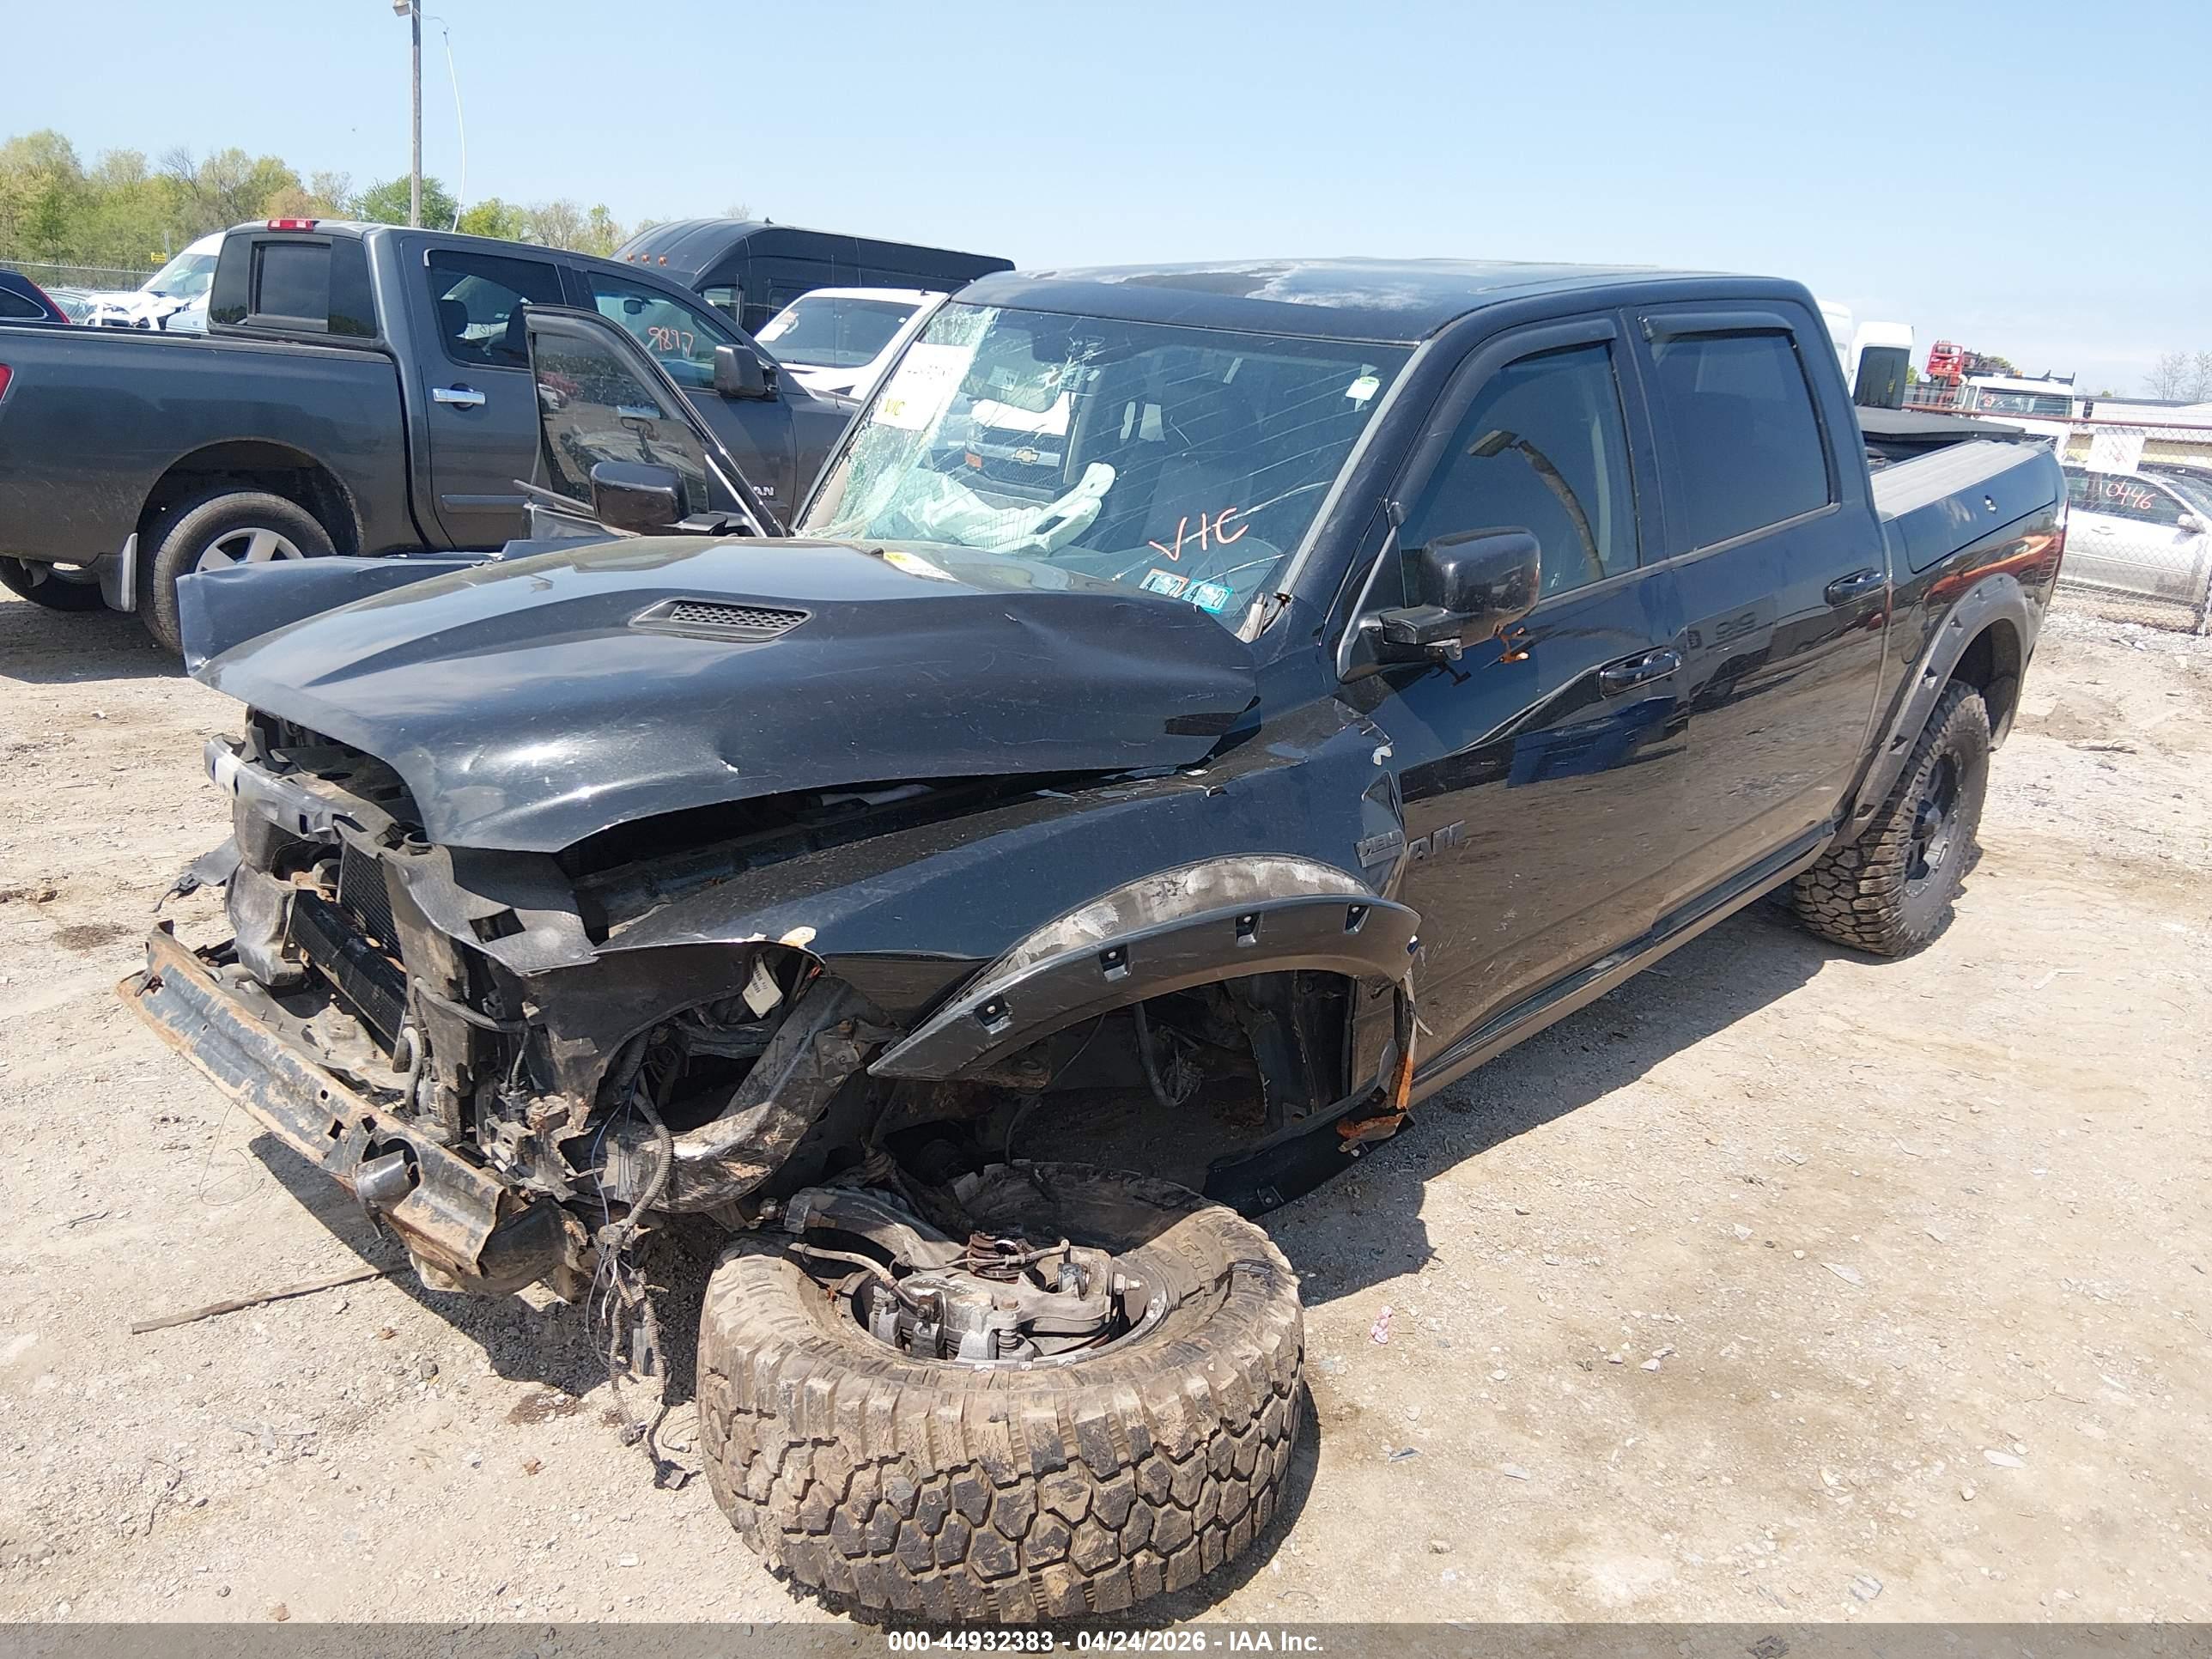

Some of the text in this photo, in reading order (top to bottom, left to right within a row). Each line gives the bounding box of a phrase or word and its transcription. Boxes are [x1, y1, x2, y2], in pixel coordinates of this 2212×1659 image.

[753, 486, 775, 496] AN
[1146, 577, 1157, 590] 4
[1190, 586, 1200, 602] 4
[1406, 819, 1466, 860] AM
